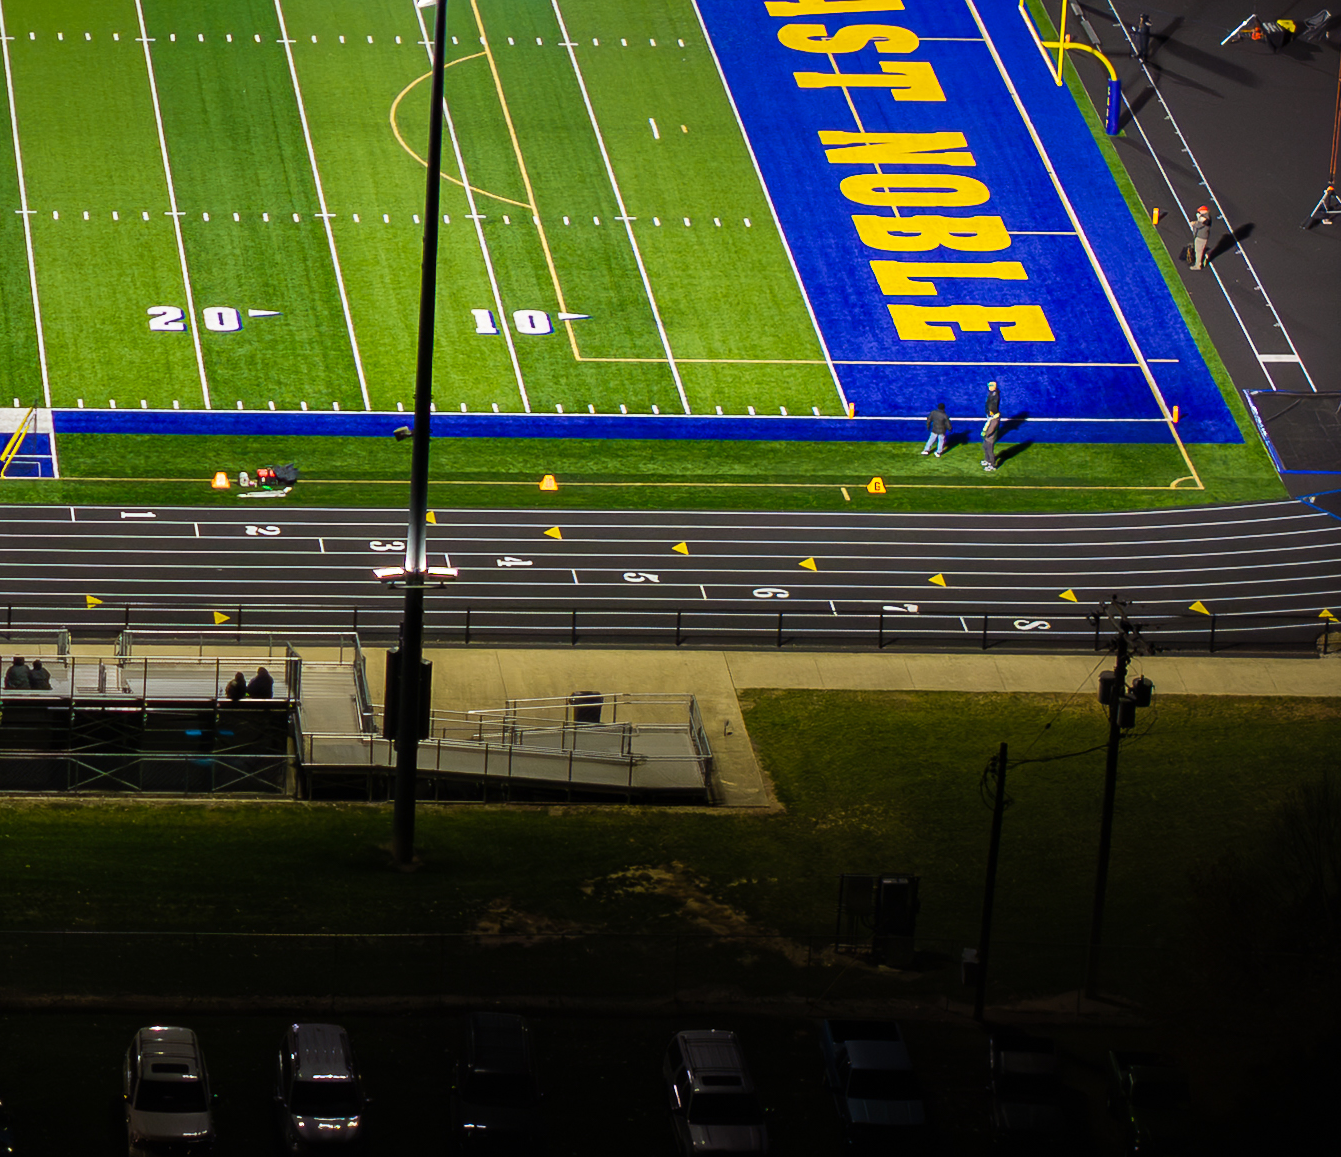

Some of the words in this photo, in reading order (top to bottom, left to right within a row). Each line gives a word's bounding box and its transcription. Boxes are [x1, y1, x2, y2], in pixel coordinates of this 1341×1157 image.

[817, 130, 1056, 342] NOBLE
[145, 304, 242, 333] 20
[470, 307, 555, 335] 10
[119, 511, 157, 520] 1
[245, 524, 282, 537] 2
[369, 540, 406, 553] 3
[496, 555, 534, 569] 4
[623, 571, 661, 584] 5
[751, 587, 790, 599] 6
[882, 603, 920, 615] 7
[1013, 618, 1052, 632] 8
